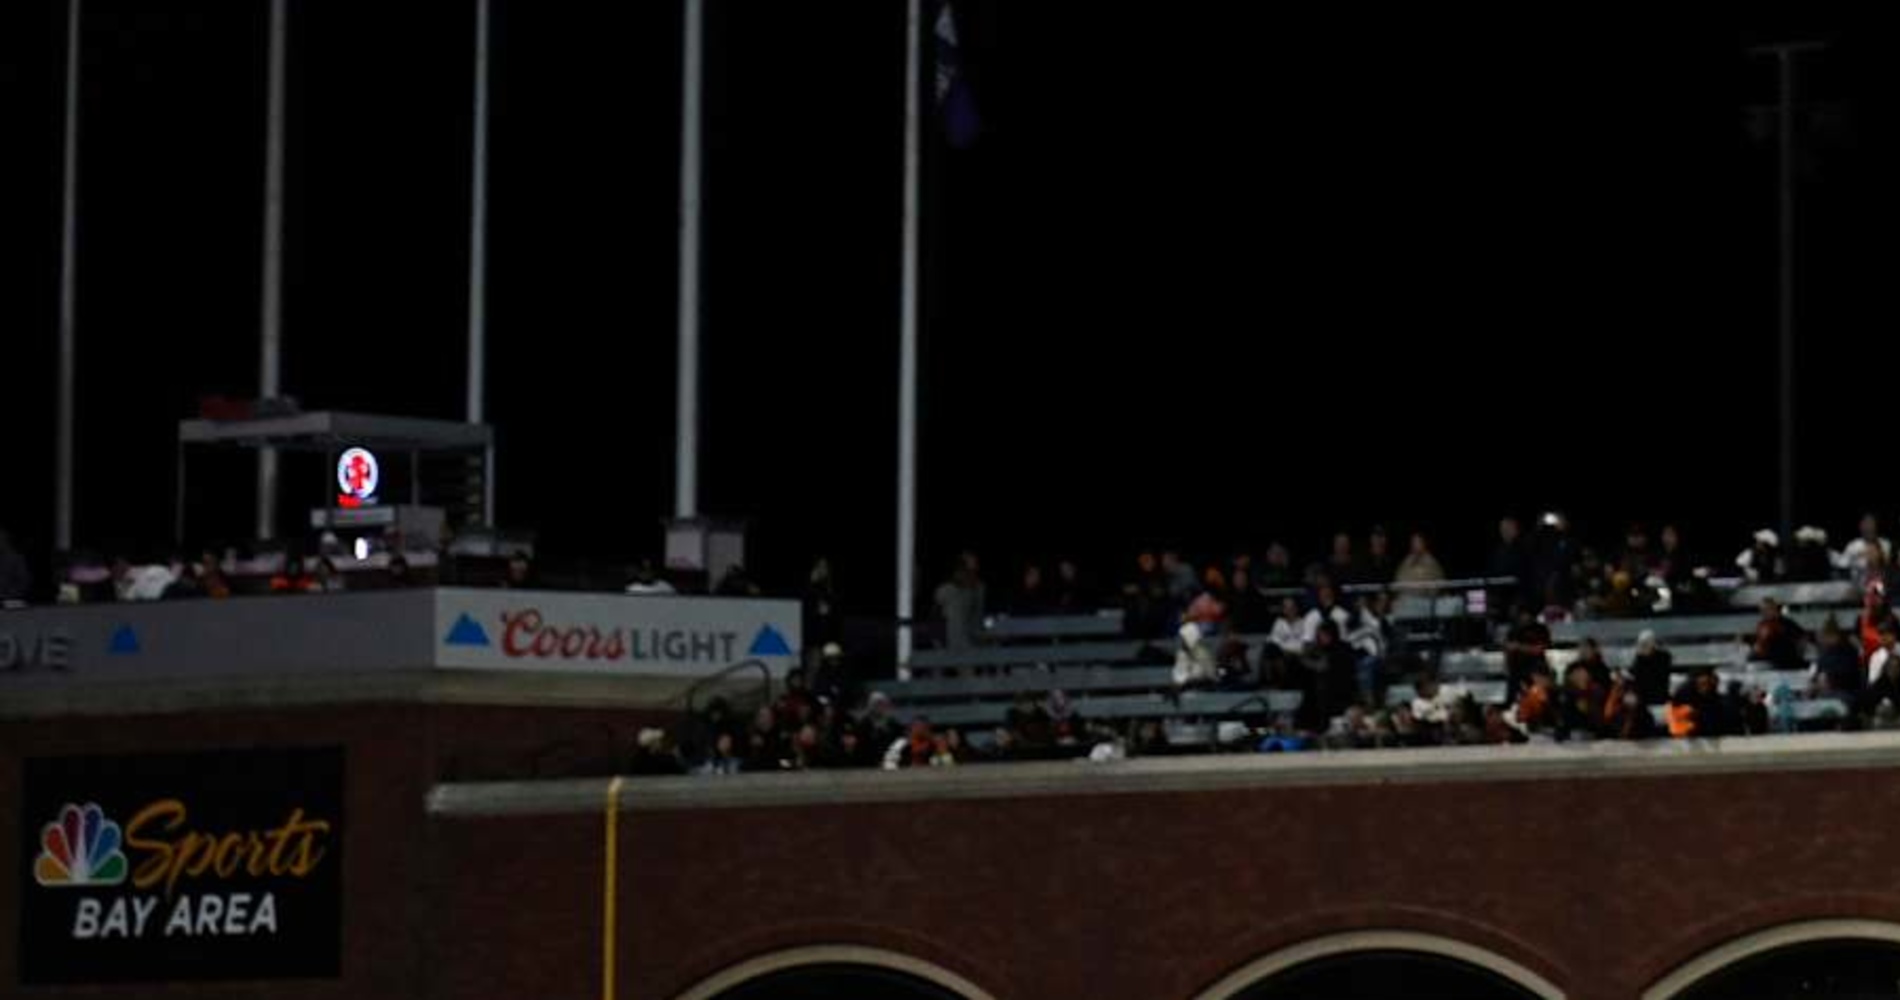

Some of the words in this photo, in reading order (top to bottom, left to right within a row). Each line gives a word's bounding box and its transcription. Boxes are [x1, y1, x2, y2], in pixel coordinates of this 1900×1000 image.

[503, 609, 624, 661] Coors
[631, 629, 737, 662] LIGHT
[125, 796, 331, 899] Sports
[72, 893, 160, 939] BAY
[164, 891, 278, 938] AREA
